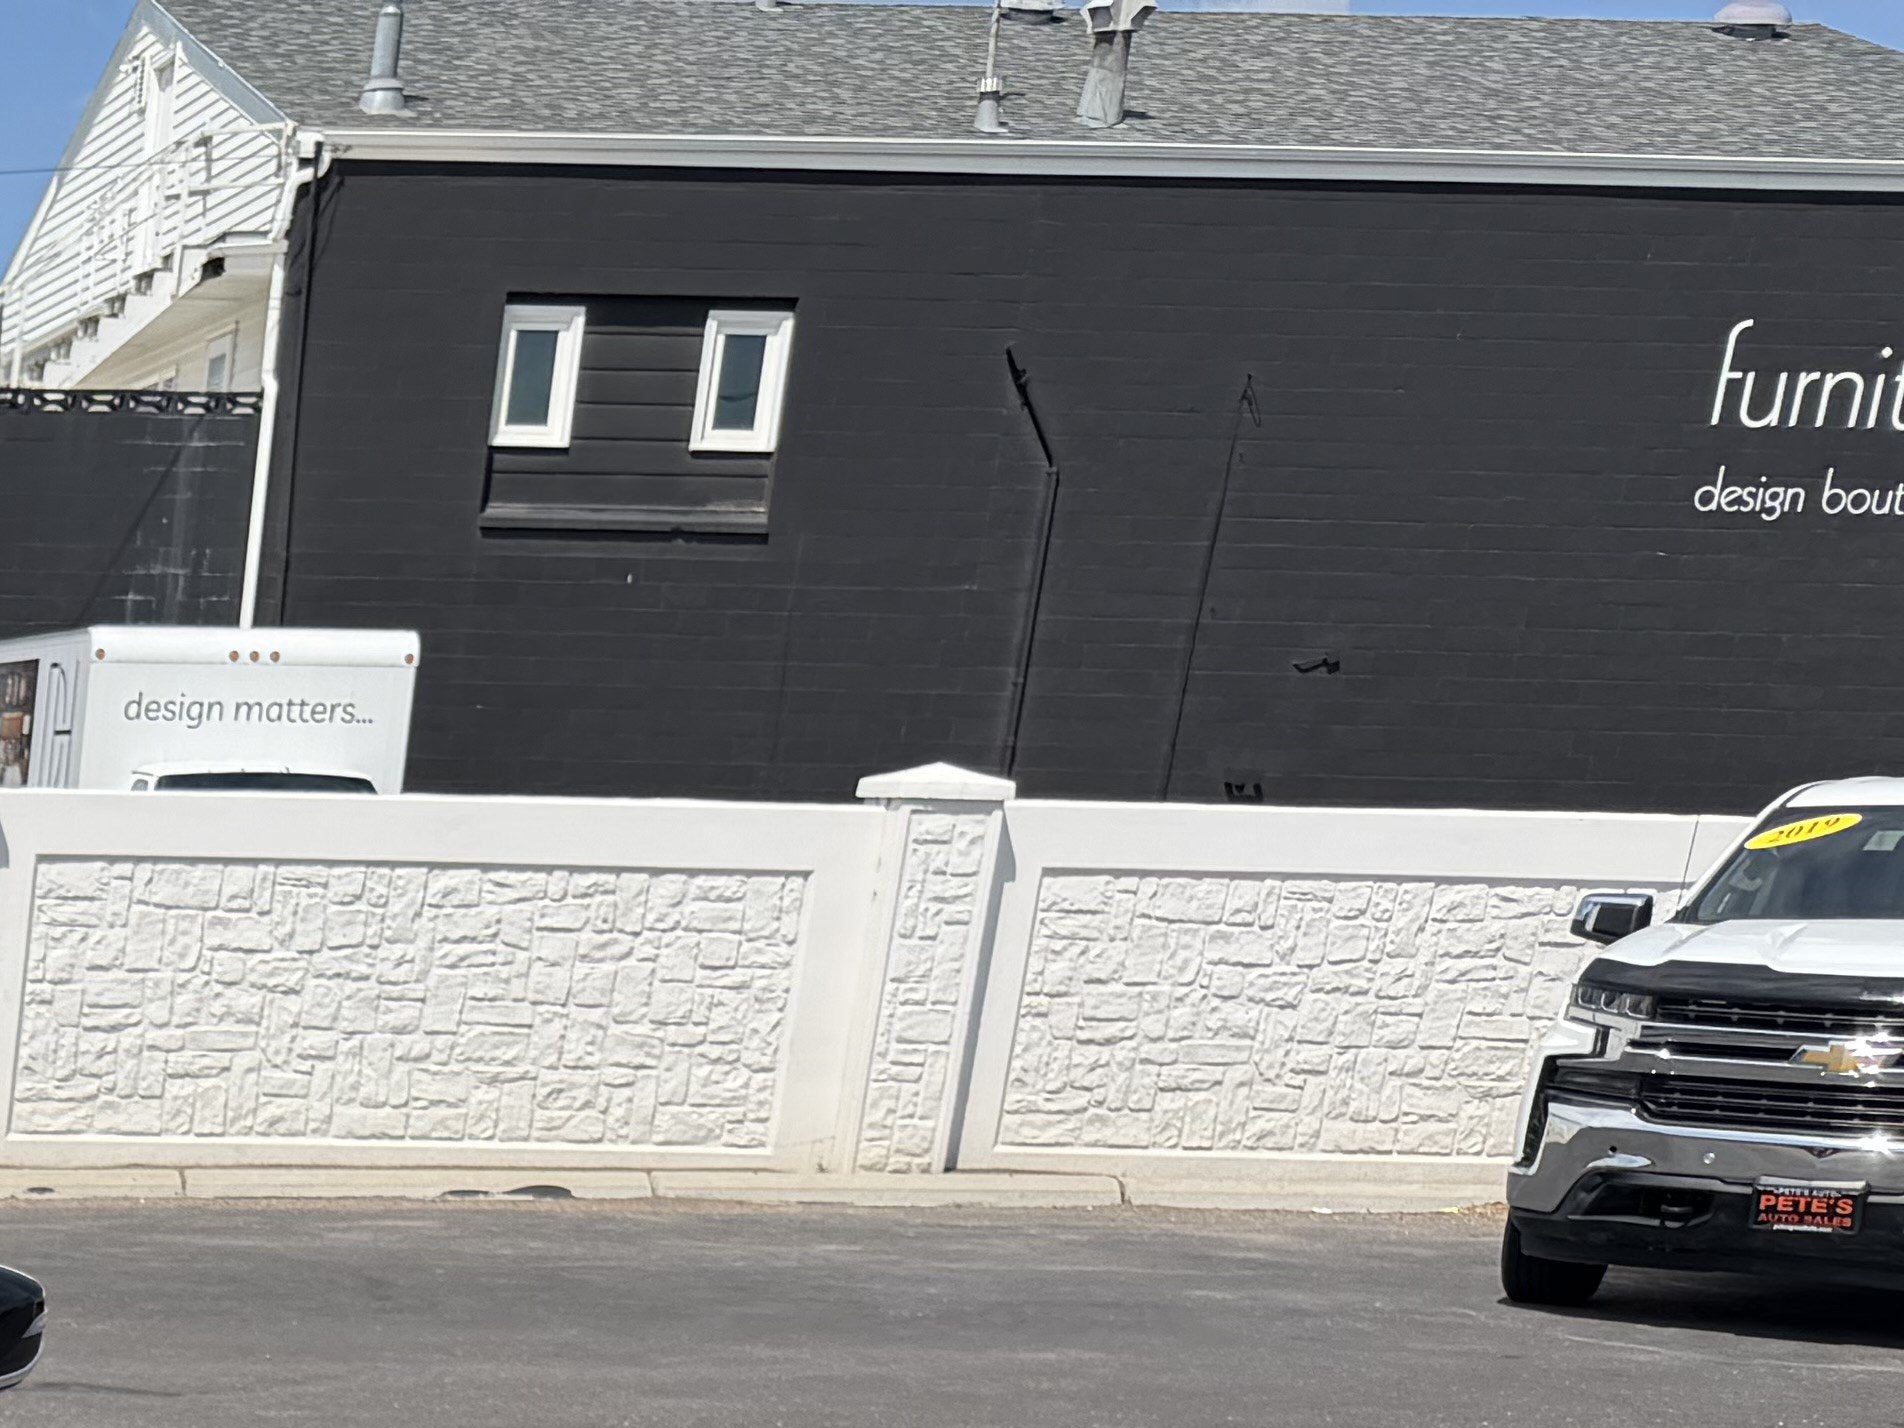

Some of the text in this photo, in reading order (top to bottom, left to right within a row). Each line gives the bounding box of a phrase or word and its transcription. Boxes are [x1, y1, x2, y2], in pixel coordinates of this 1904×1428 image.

[1694, 465, 1904, 521] design bout
[123, 691, 374, 729] design matters...
[1757, 1212, 1800, 1223] AUTO
[1759, 1194, 1853, 1215] PETE'S
